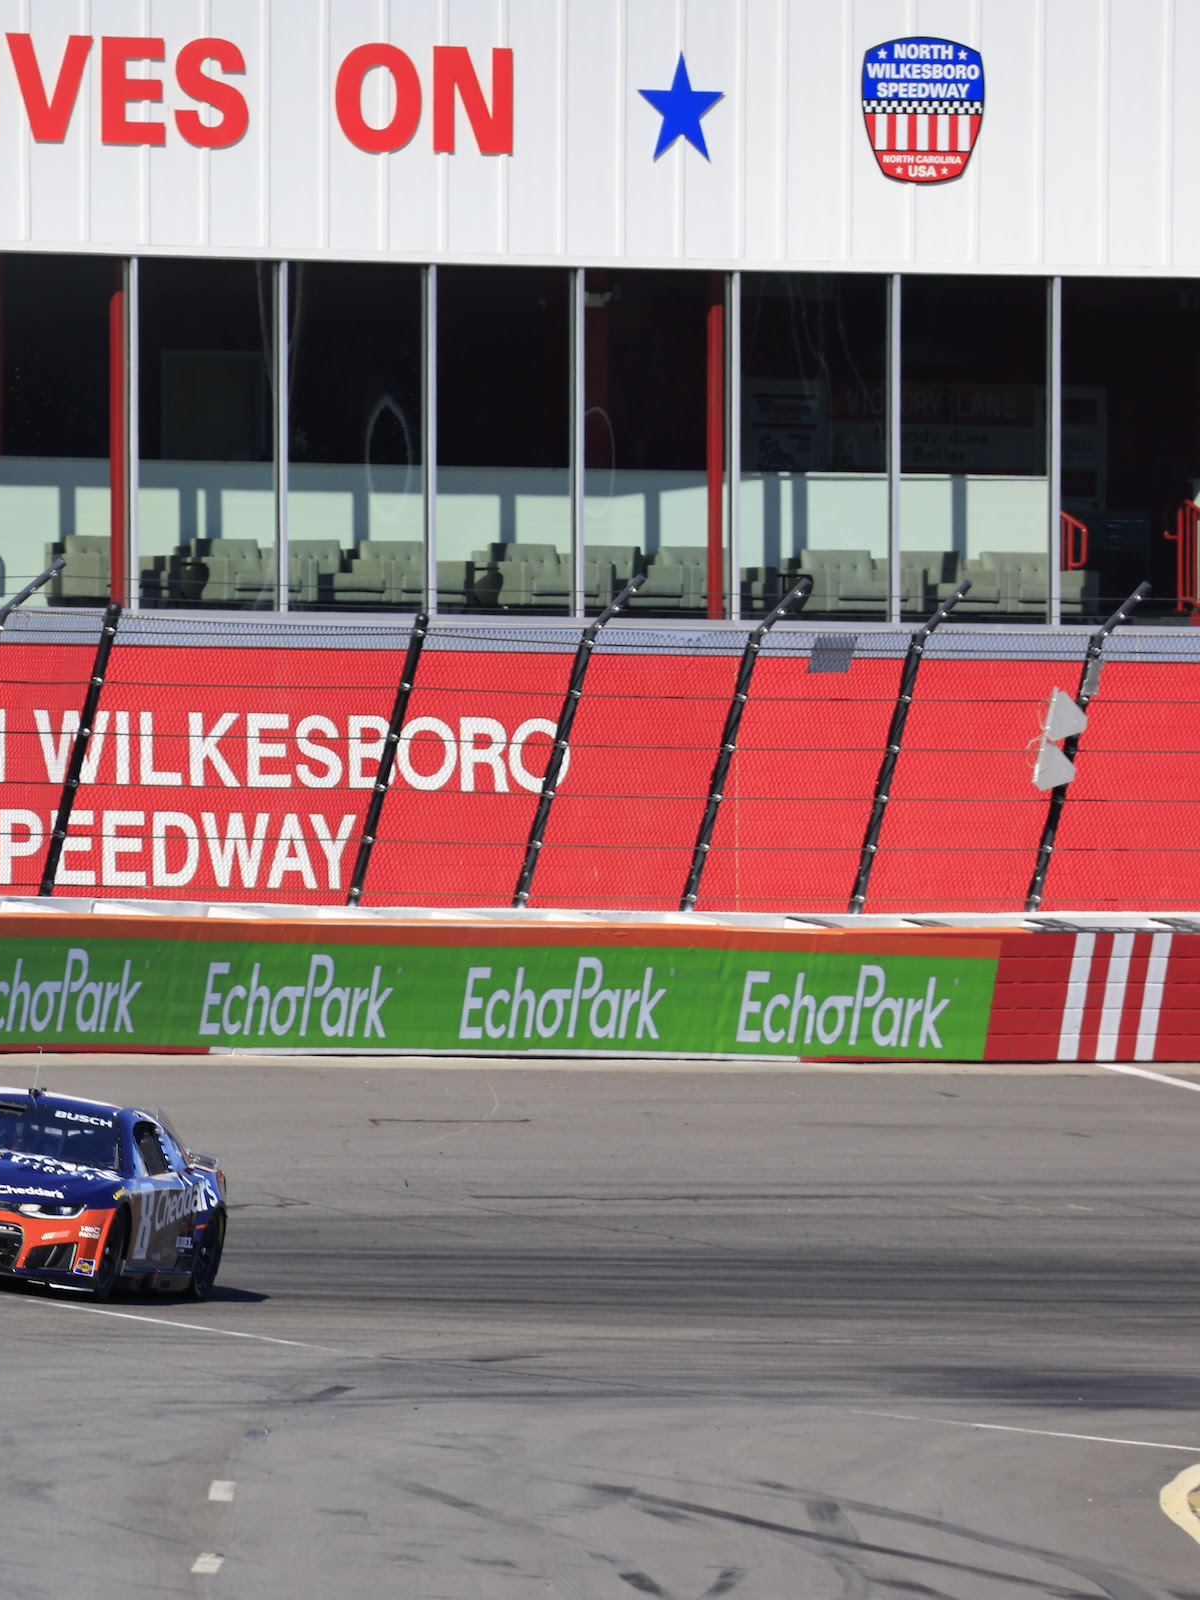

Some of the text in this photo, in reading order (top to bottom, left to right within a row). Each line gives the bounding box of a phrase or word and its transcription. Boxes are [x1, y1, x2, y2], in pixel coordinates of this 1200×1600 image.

[866, 63, 980, 80] WILKESBORO
[894, 44, 953, 60] NORTH
[336, 43, 512, 153] ON
[876, 82, 970, 98] SPEEDWAY
[882, 154, 962, 164] NORTH CAROLINA
[907, 165, 937, 178] USA
[844, 387, 1018, 419] VICORY LANE
[33, 709, 570, 793] WILKESBORO
[199, 953, 394, 1039] EchoPark
[458, 956, 667, 1040] EchoPark
[736, 964, 950, 1049] EchoPark
[54, 1110, 113, 1128] BUSCH
[131, 1183, 155, 1260] 8
[154, 1172, 219, 1231] Cheddar's
